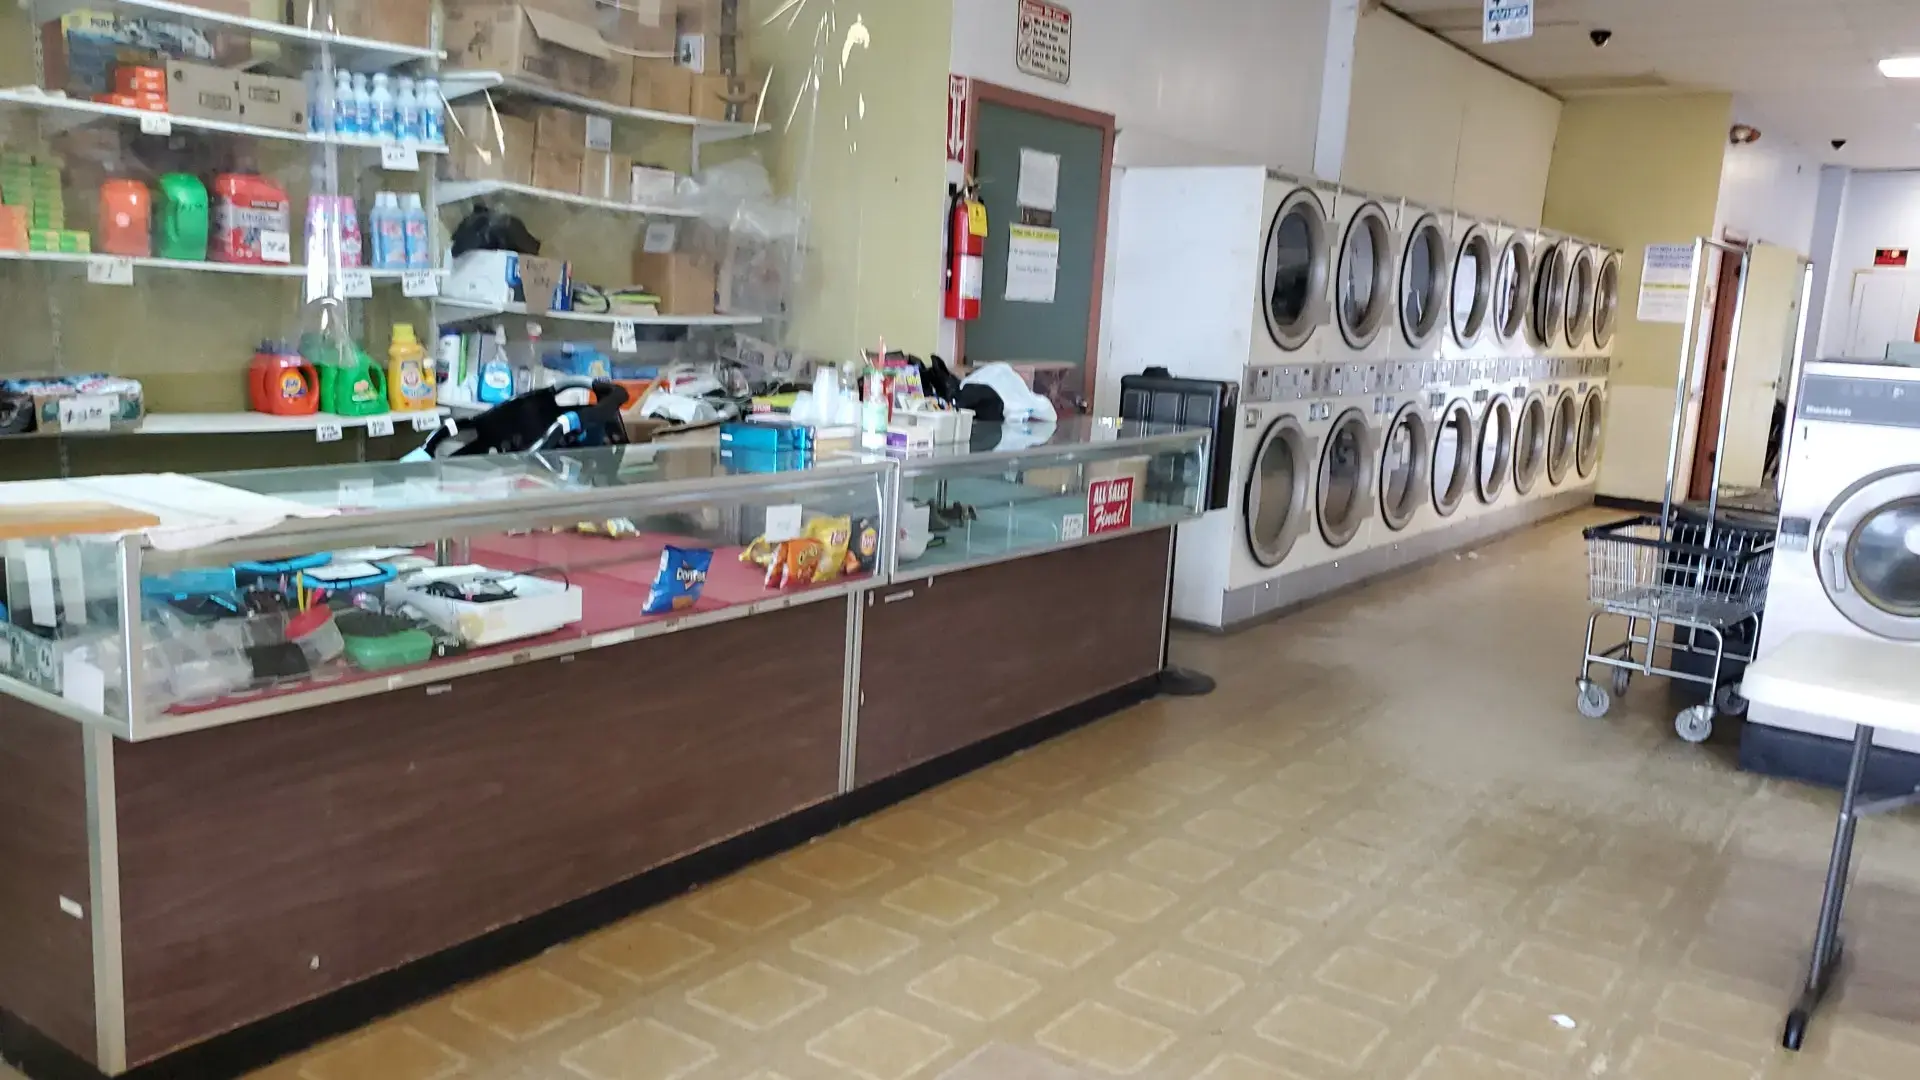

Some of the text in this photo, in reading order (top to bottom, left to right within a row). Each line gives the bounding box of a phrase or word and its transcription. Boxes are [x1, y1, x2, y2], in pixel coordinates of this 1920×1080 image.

[1093, 481, 1129, 506] ALL SALES
[1094, 501, 1128, 533] Final!
[676, 566, 706, 583] Doritos
